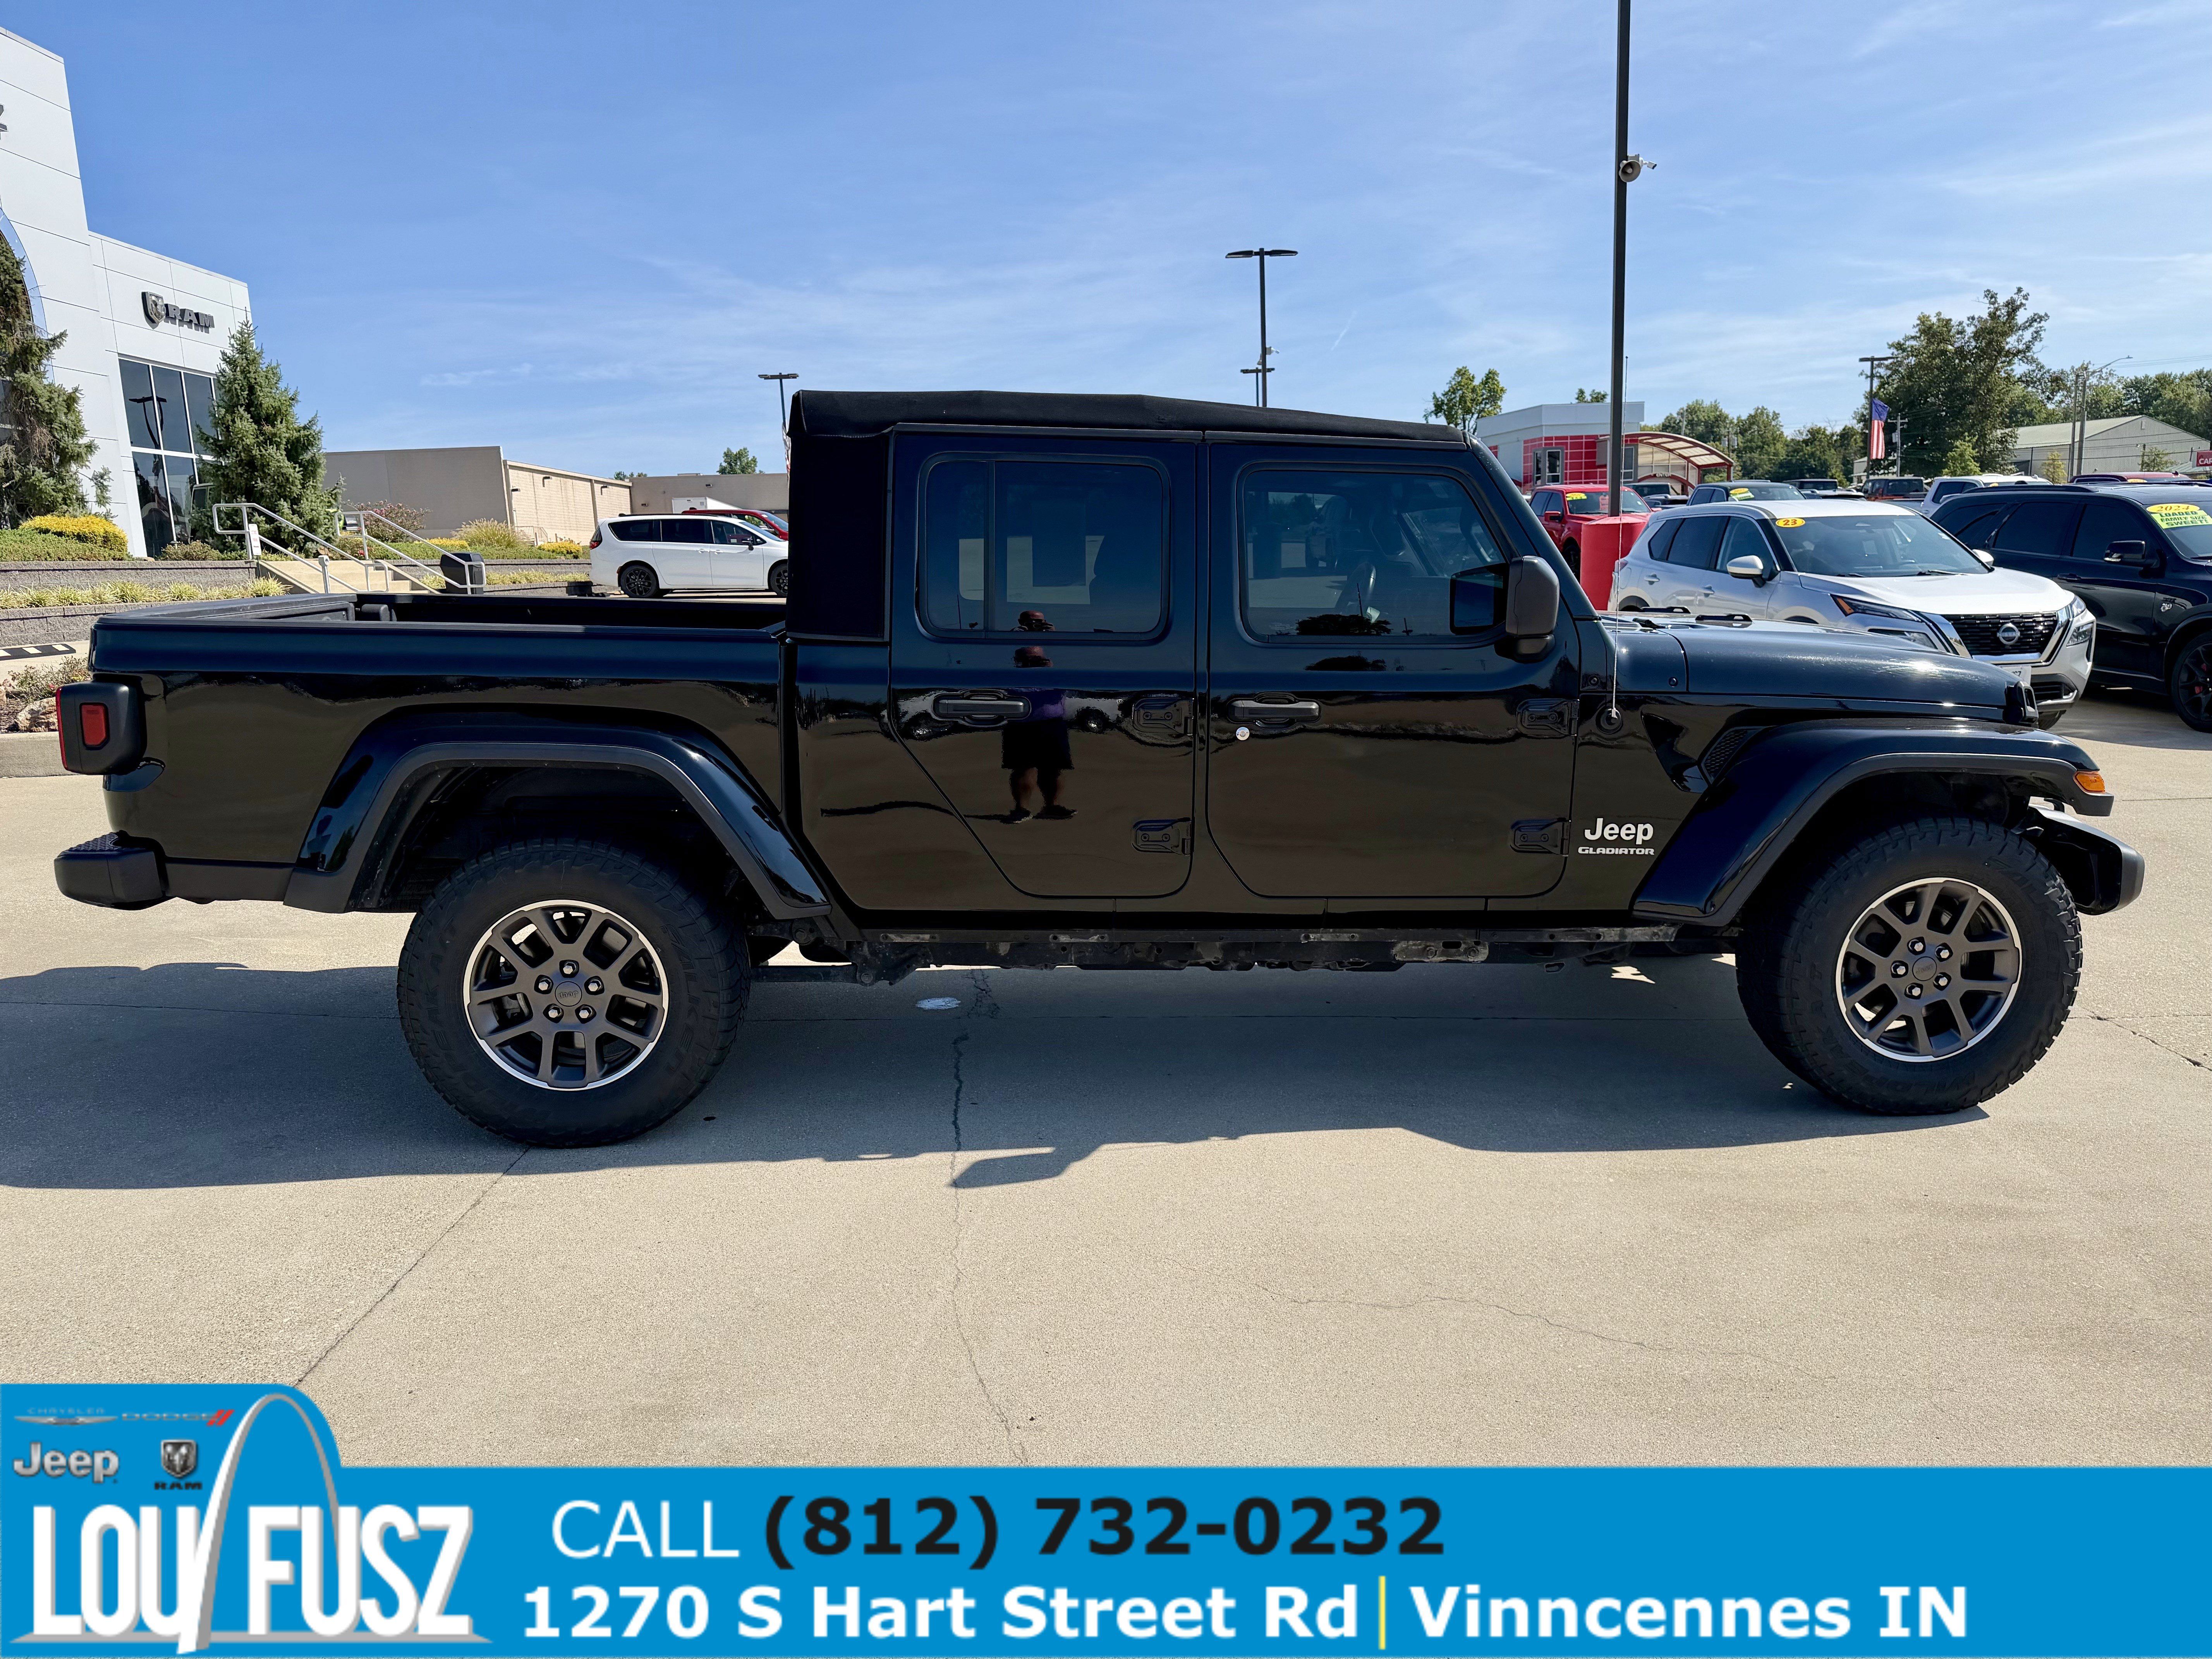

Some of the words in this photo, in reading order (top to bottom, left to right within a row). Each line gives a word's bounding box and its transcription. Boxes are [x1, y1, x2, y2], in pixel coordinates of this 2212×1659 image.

[164, 304, 215, 328] RAM
[1585, 818, 1654, 845] Jeep
[1578, 847, 1655, 855] GLADIATOR
